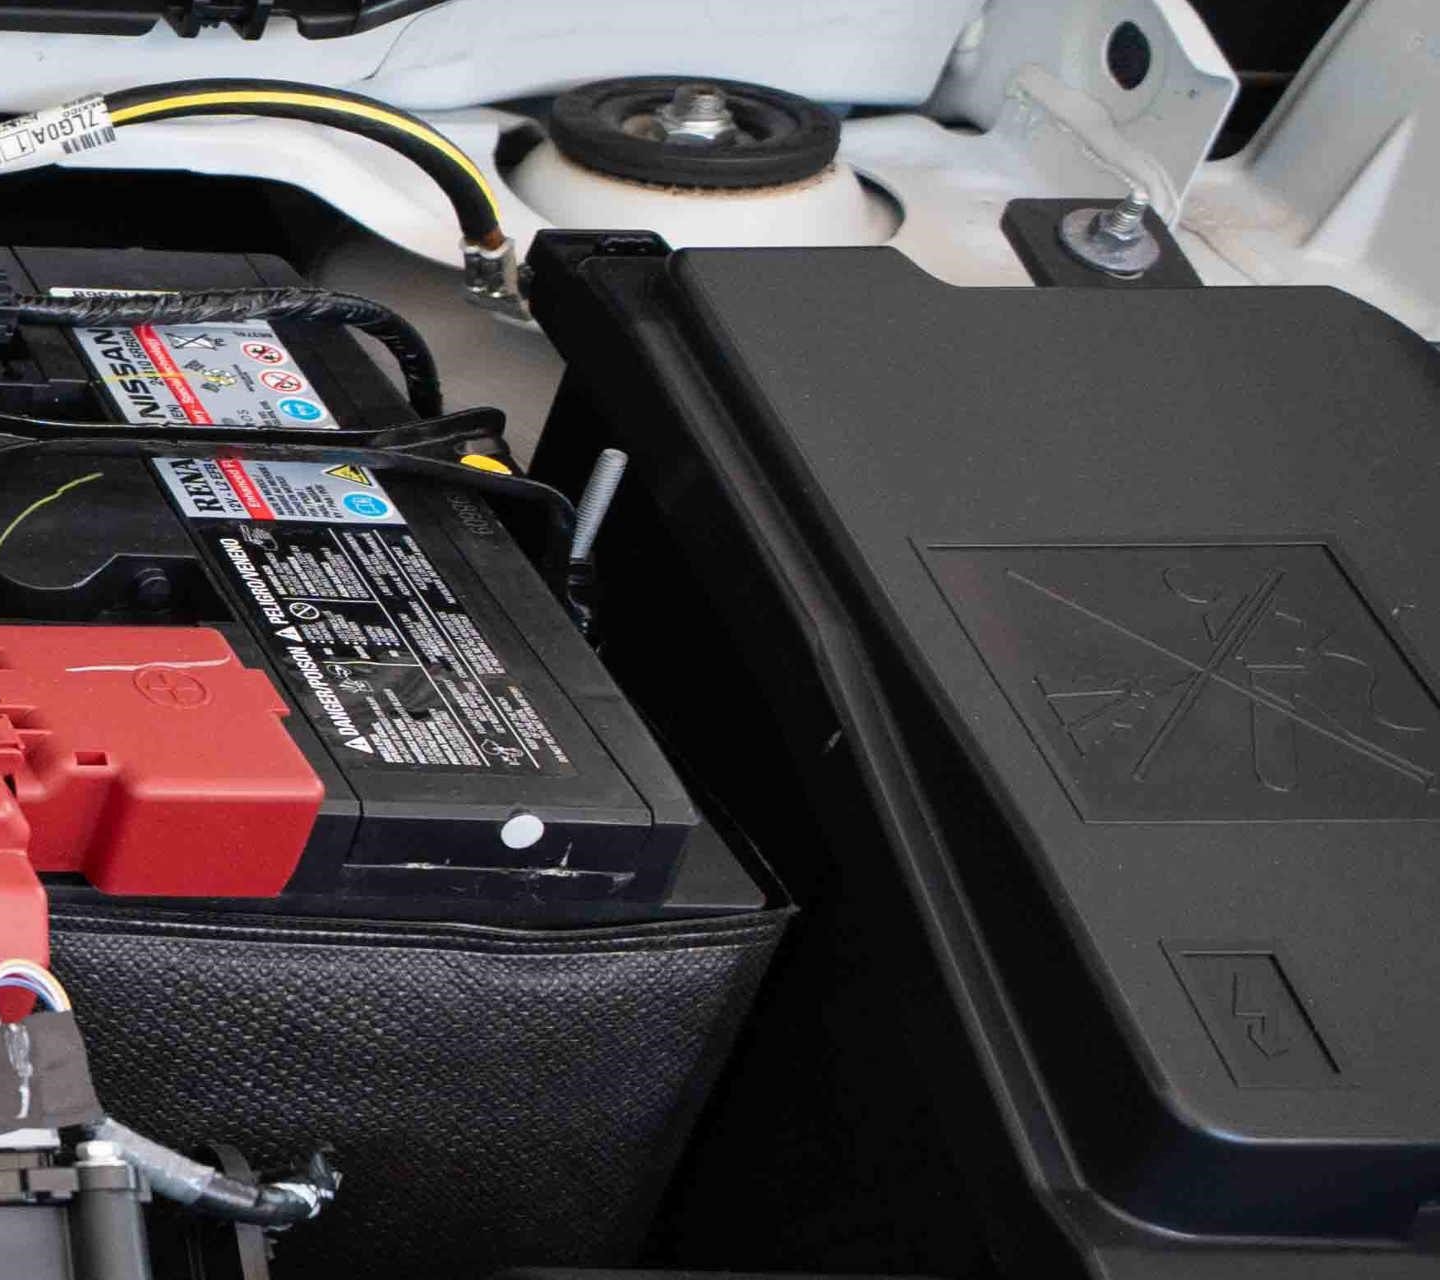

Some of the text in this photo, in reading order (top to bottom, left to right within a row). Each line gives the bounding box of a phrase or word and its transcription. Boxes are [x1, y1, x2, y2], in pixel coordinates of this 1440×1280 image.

[87, 328, 166, 420] NISSAN
[169, 459, 225, 513] RENA
[220, 537, 289, 626] PELIGRO/VENENO
[286, 646, 359, 737] DANGER/POISON
